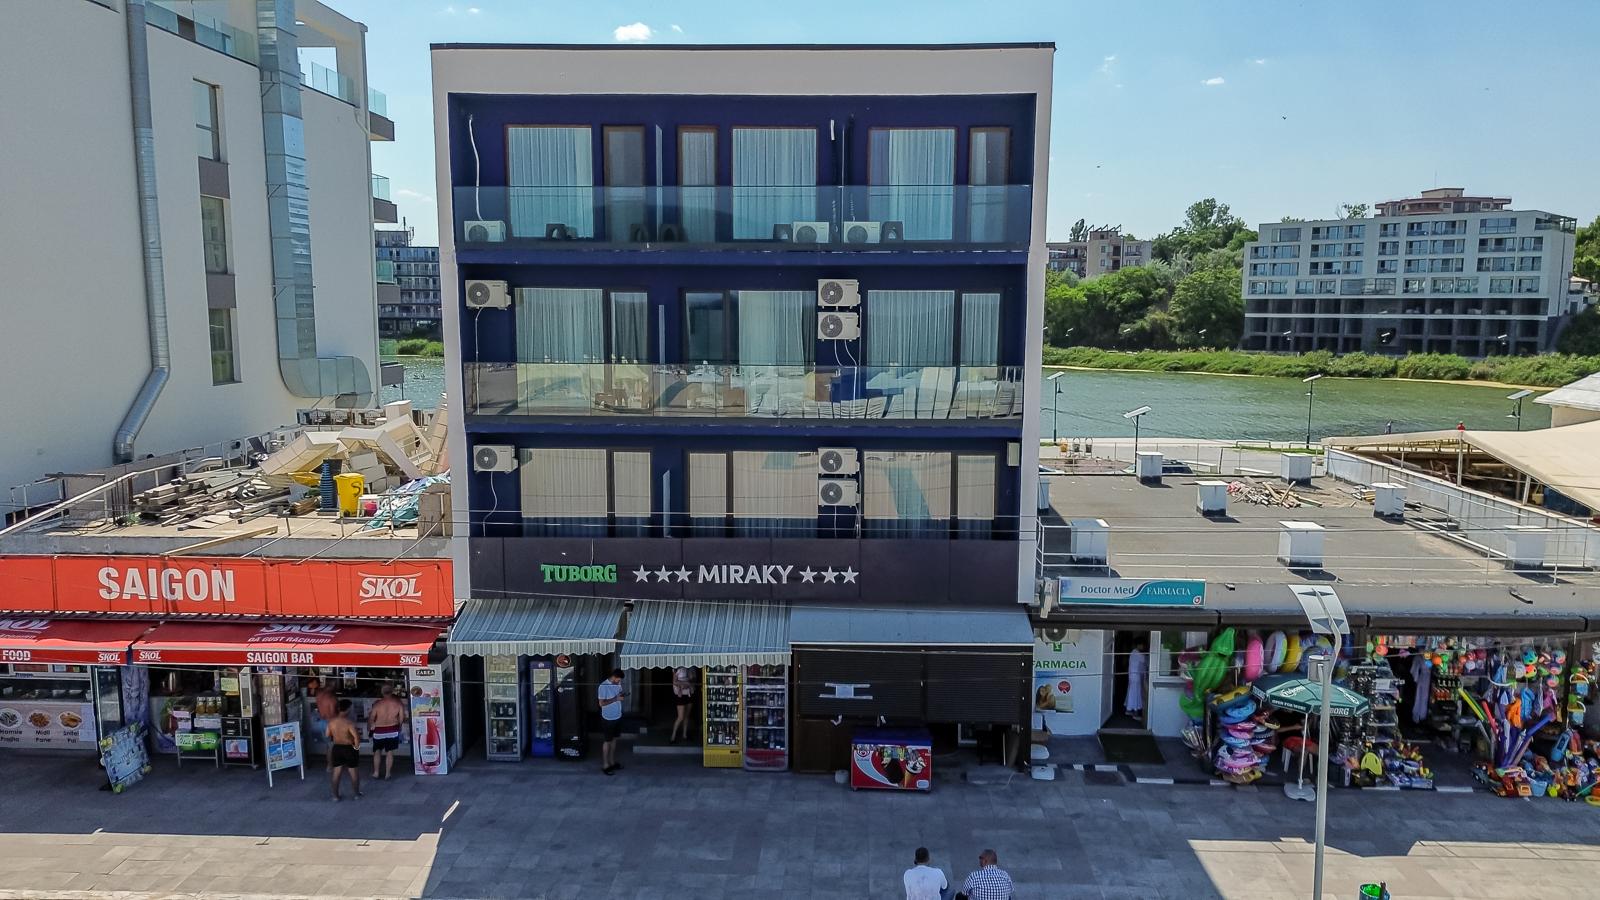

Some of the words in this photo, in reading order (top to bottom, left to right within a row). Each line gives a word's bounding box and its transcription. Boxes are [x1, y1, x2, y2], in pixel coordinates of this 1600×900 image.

[541, 564, 617, 583] TUBORG
[697, 565, 794, 584] MIRAKY
[98, 567, 235, 601] SAIGON
[359, 577, 422, 599] SKOL
[1080, 585, 1111, 594] Doctor
[1114, 585, 1134, 594] Med
[1147, 585, 1191, 595] FARMACIA
[2, 650, 31, 661] FOOD
[98, 652, 120, 663] SKOL
[139, 651, 161, 662] SKOL
[246, 652, 288, 663] SAIGON
[291, 652, 314, 664] BAR
[400, 655, 421, 665] SKOL
